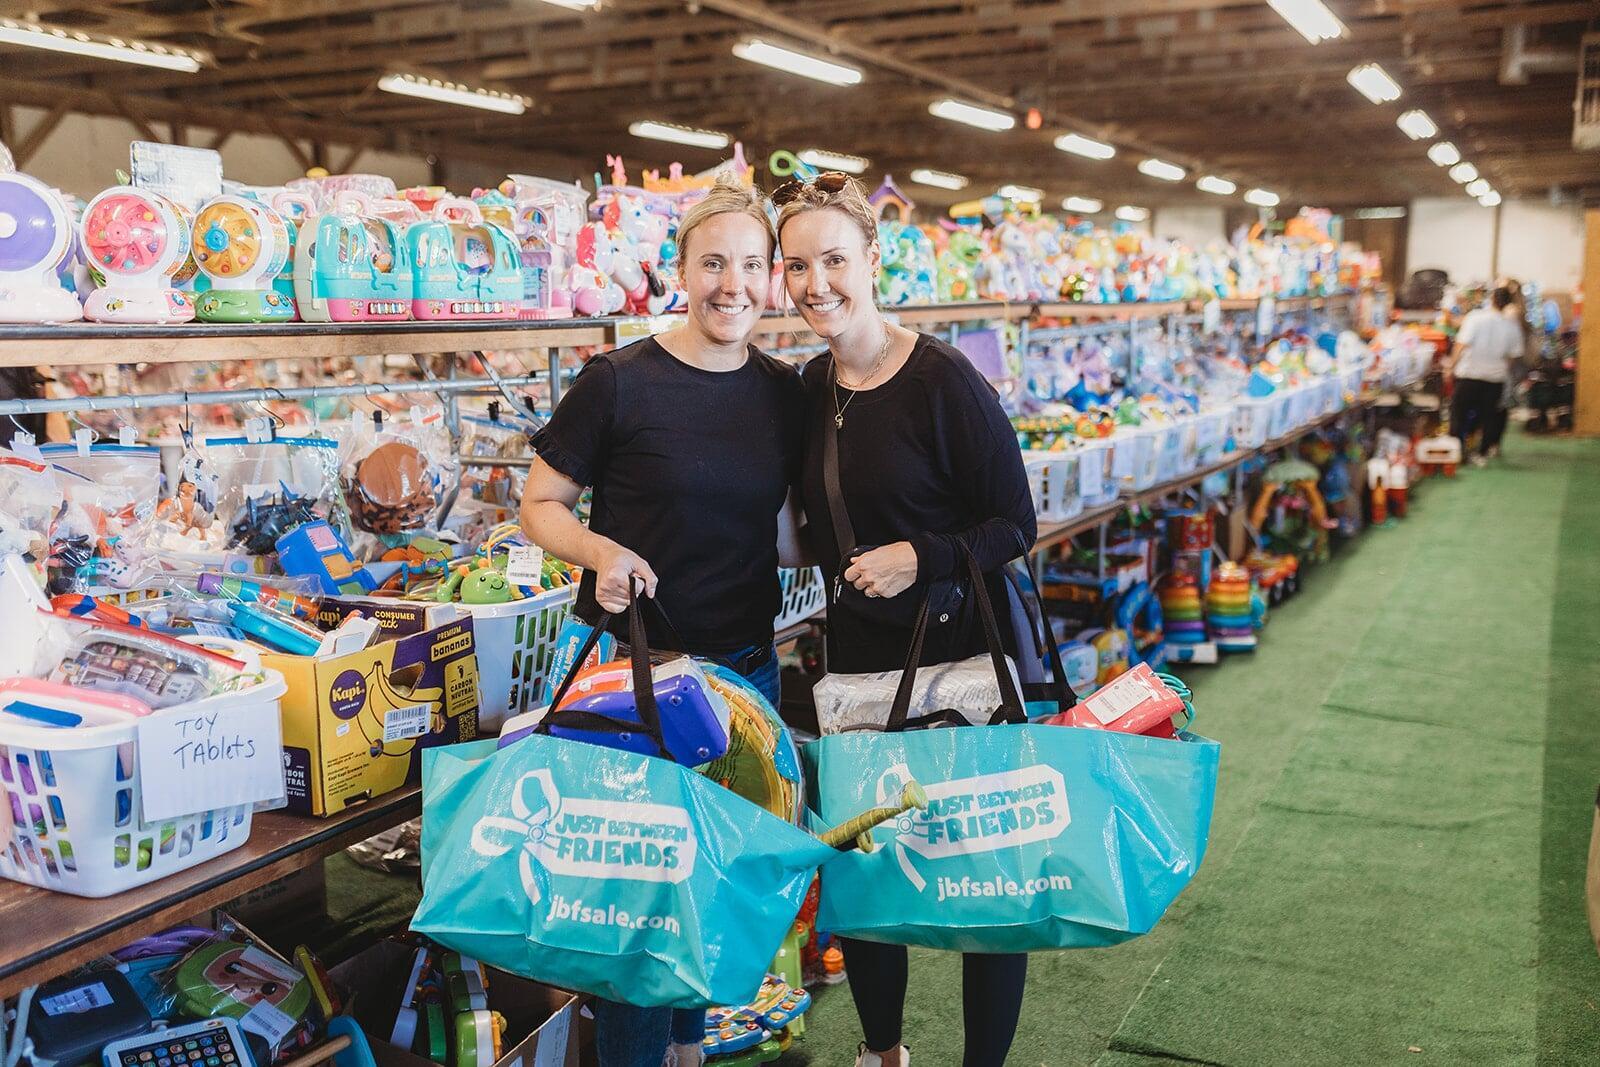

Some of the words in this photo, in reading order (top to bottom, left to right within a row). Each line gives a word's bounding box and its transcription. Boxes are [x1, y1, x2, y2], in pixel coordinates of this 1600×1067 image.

[317, 607, 340, 626] api
[374, 610, 416, 621] CONSUMER
[380, 617, 399, 629] ack
[437, 625, 462, 641] PREMIUM
[432, 636, 471, 658] bananas
[332, 681, 362, 702] Kapi
[450, 677, 474, 693] CARBON
[450, 687, 475, 701] NEUTRAL
[174, 712, 218, 738] TOY
[287, 769, 304, 779] BON
[287, 778, 306, 787] TRAL
[920, 794, 974, 821] JUST
[977, 781, 1056, 810] BETWEEN
[555, 813, 607, 834] JUST
[608, 820, 688, 842] BETWEEN
[927, 801, 1056, 845] FRIENDS
[556, 837, 680, 870] FRIENDS
[938, 875, 1073, 902] jbfsale.com
[545, 894, 681, 937] jbfsale.com
